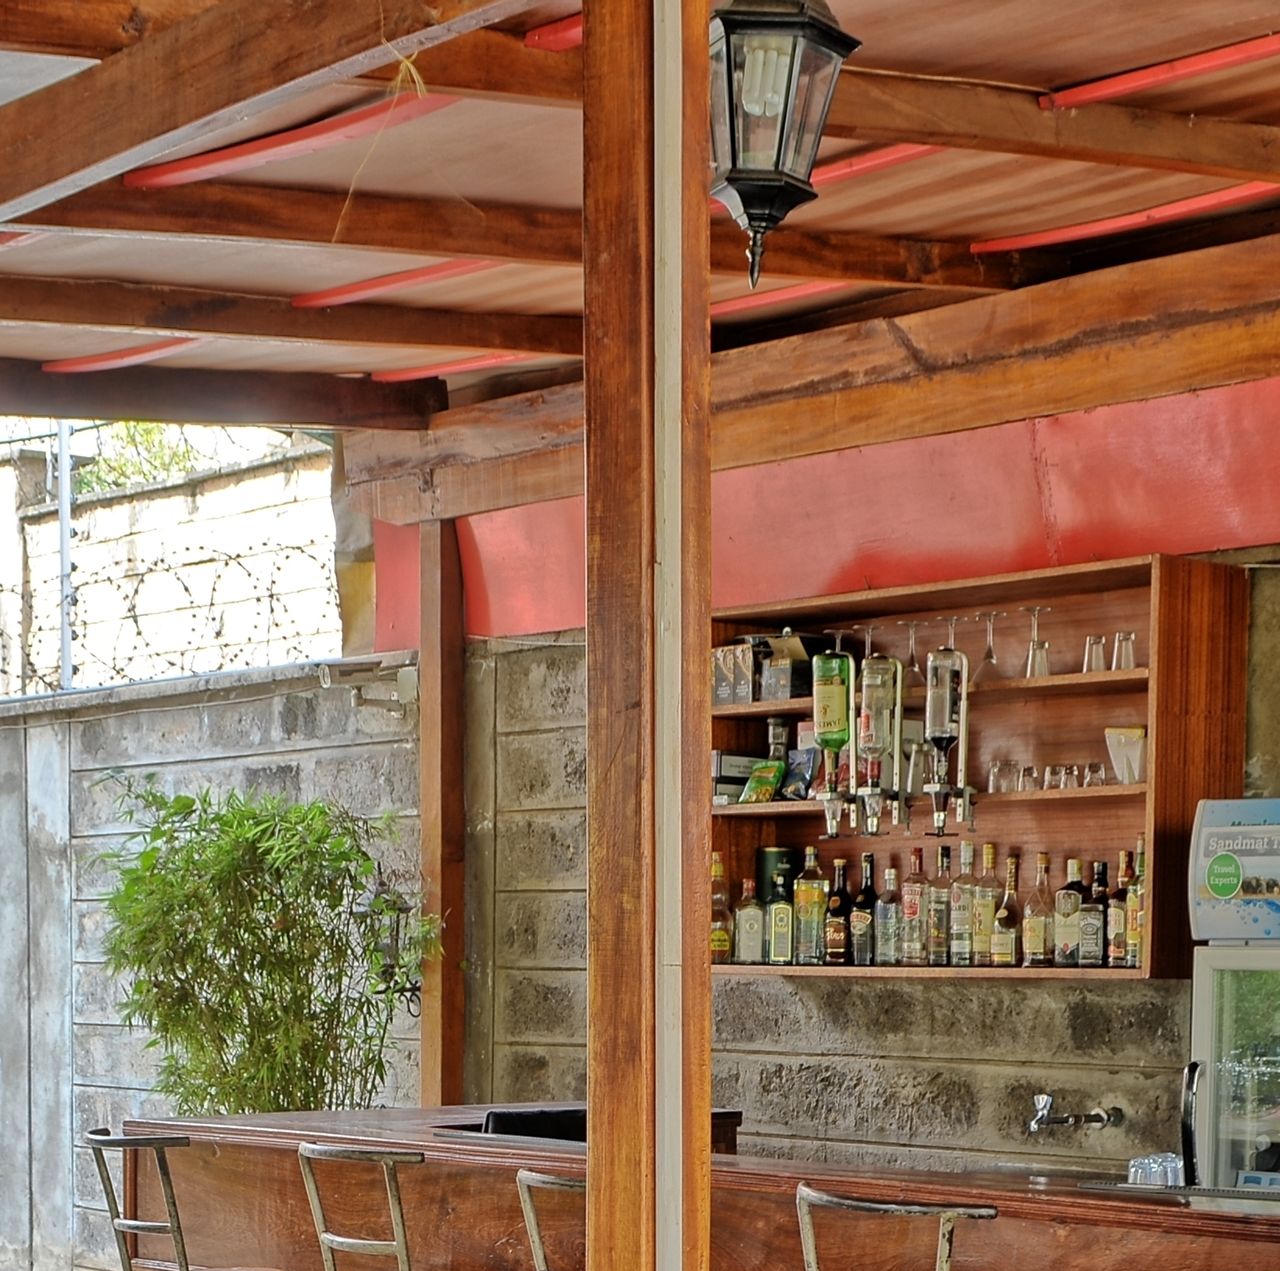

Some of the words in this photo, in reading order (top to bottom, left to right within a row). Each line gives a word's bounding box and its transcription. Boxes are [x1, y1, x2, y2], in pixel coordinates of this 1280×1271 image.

[1208, 836, 1269, 850] Sandmat
[1212, 865, 1236, 874] Travel
[1210, 875, 1238, 886] Experts
